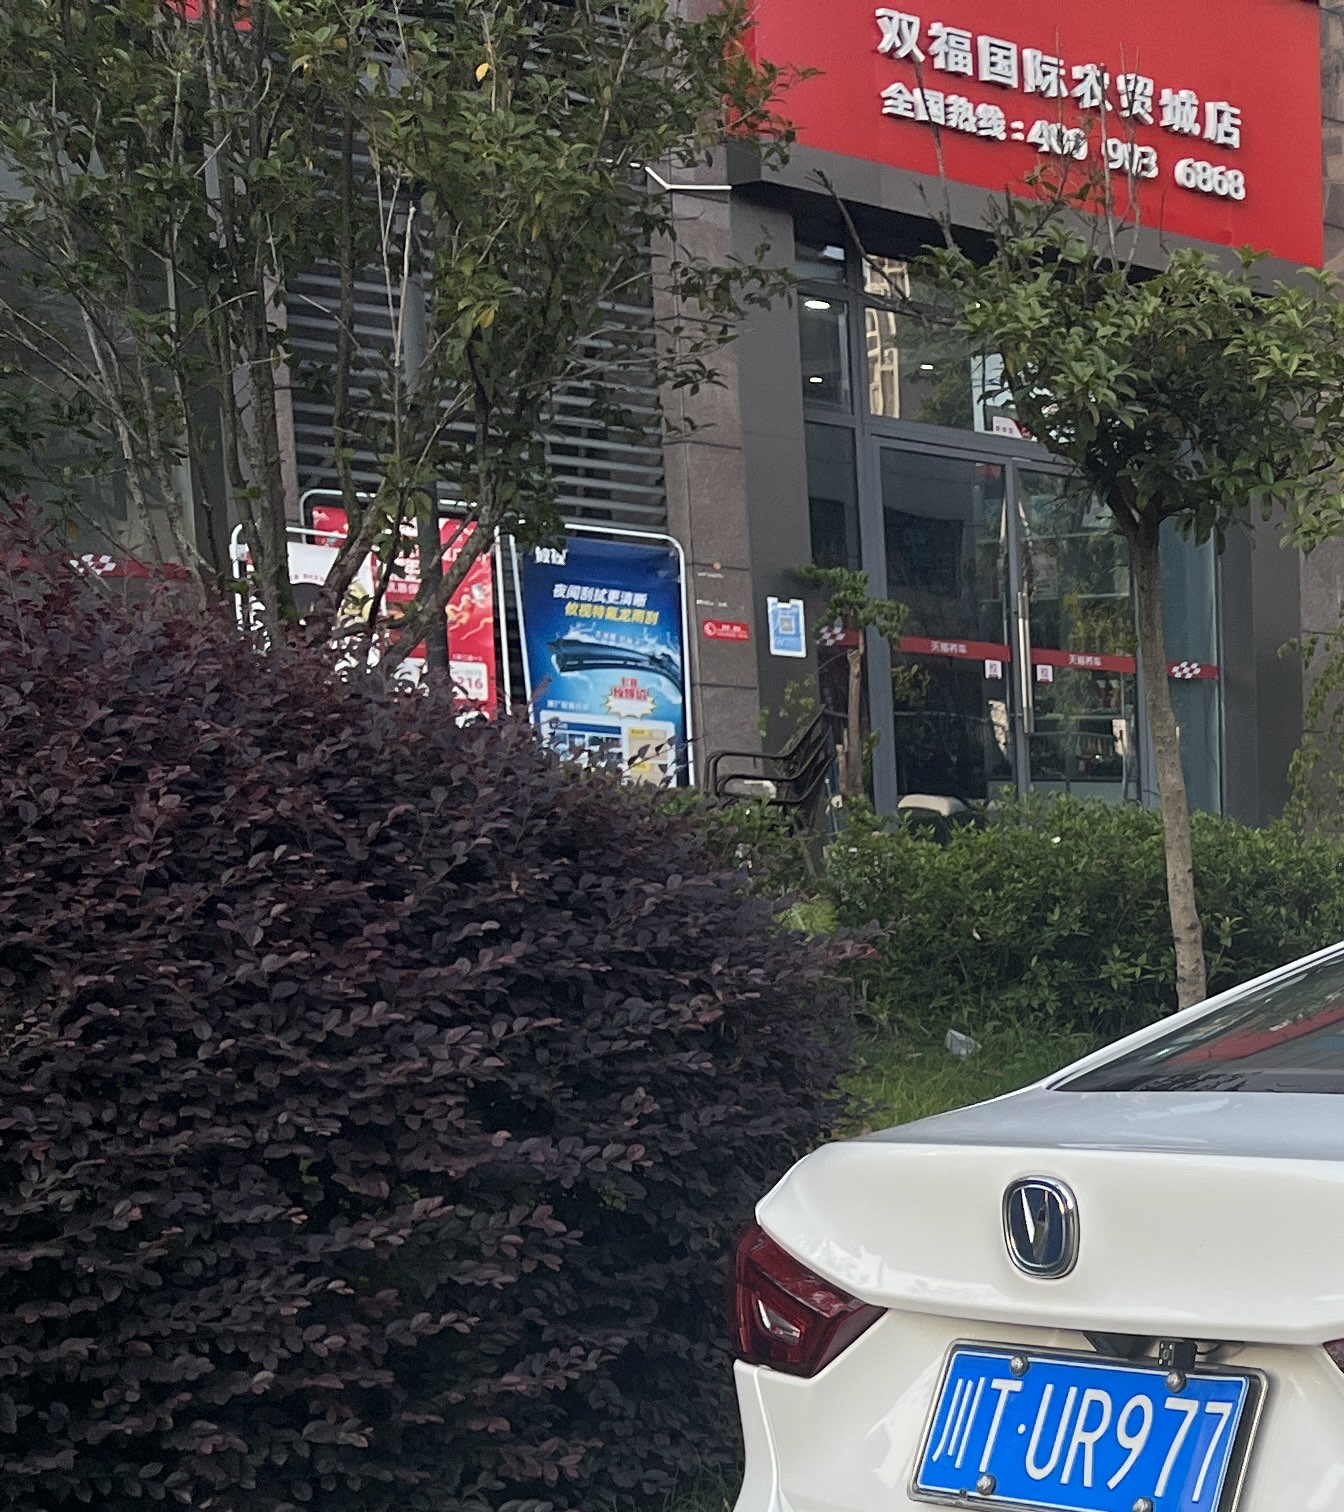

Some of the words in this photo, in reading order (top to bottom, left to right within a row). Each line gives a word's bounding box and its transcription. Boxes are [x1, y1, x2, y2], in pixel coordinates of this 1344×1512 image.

[875, 7, 1242, 149] 双福国际农贸城店
[1174, 158, 1246, 200] 6868
[932, 1377, 1232, 1504] 川T·UR977
